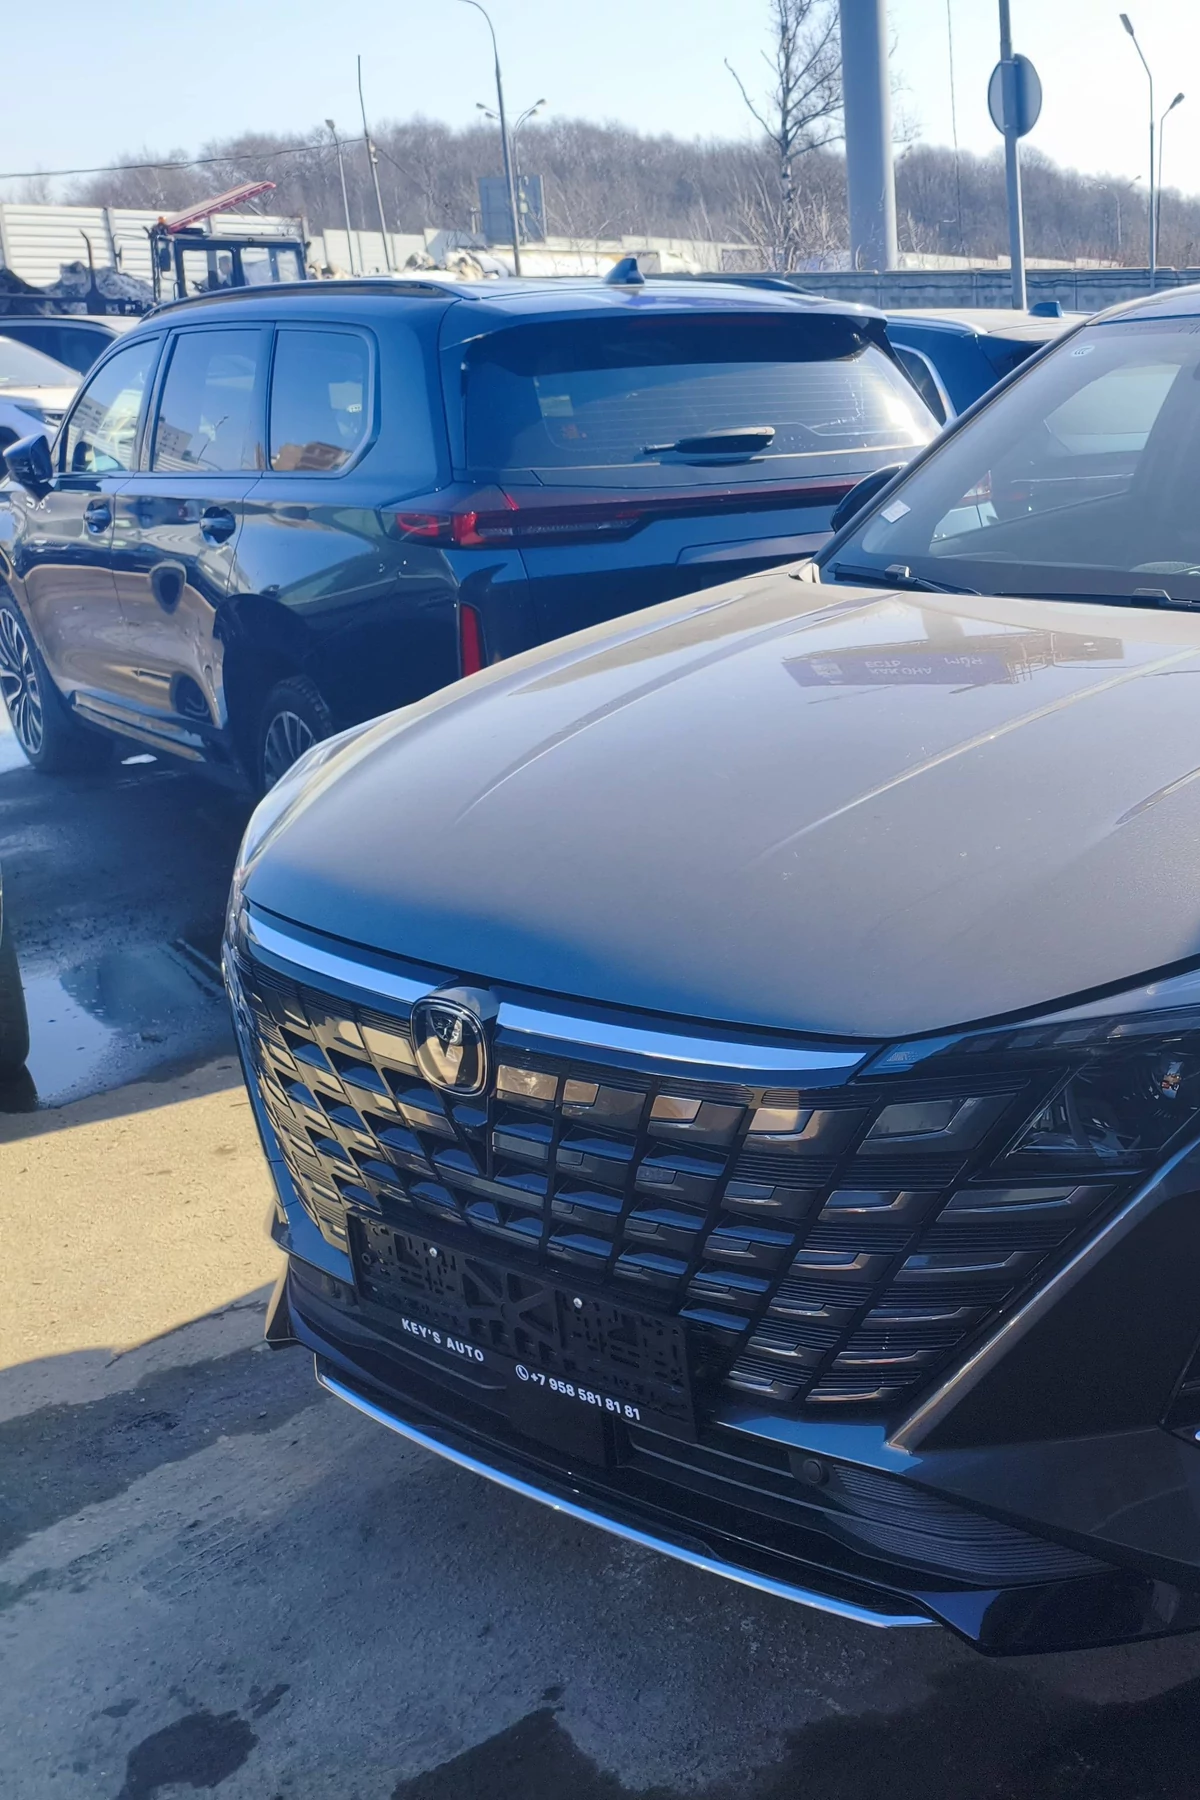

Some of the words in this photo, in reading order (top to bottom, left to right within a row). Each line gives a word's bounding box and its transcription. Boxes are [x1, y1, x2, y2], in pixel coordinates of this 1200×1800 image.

[401, 1317, 441, 1344] KEY'S
[446, 1337, 484, 1362] AUTO
[530, 1372, 545, 1386] +7
[548, 1377, 576, 1397] 958
[577, 1387, 602, 1407] 581
[605, 1398, 621, 1414] 81
[624, 1404, 640, 1421] 81
